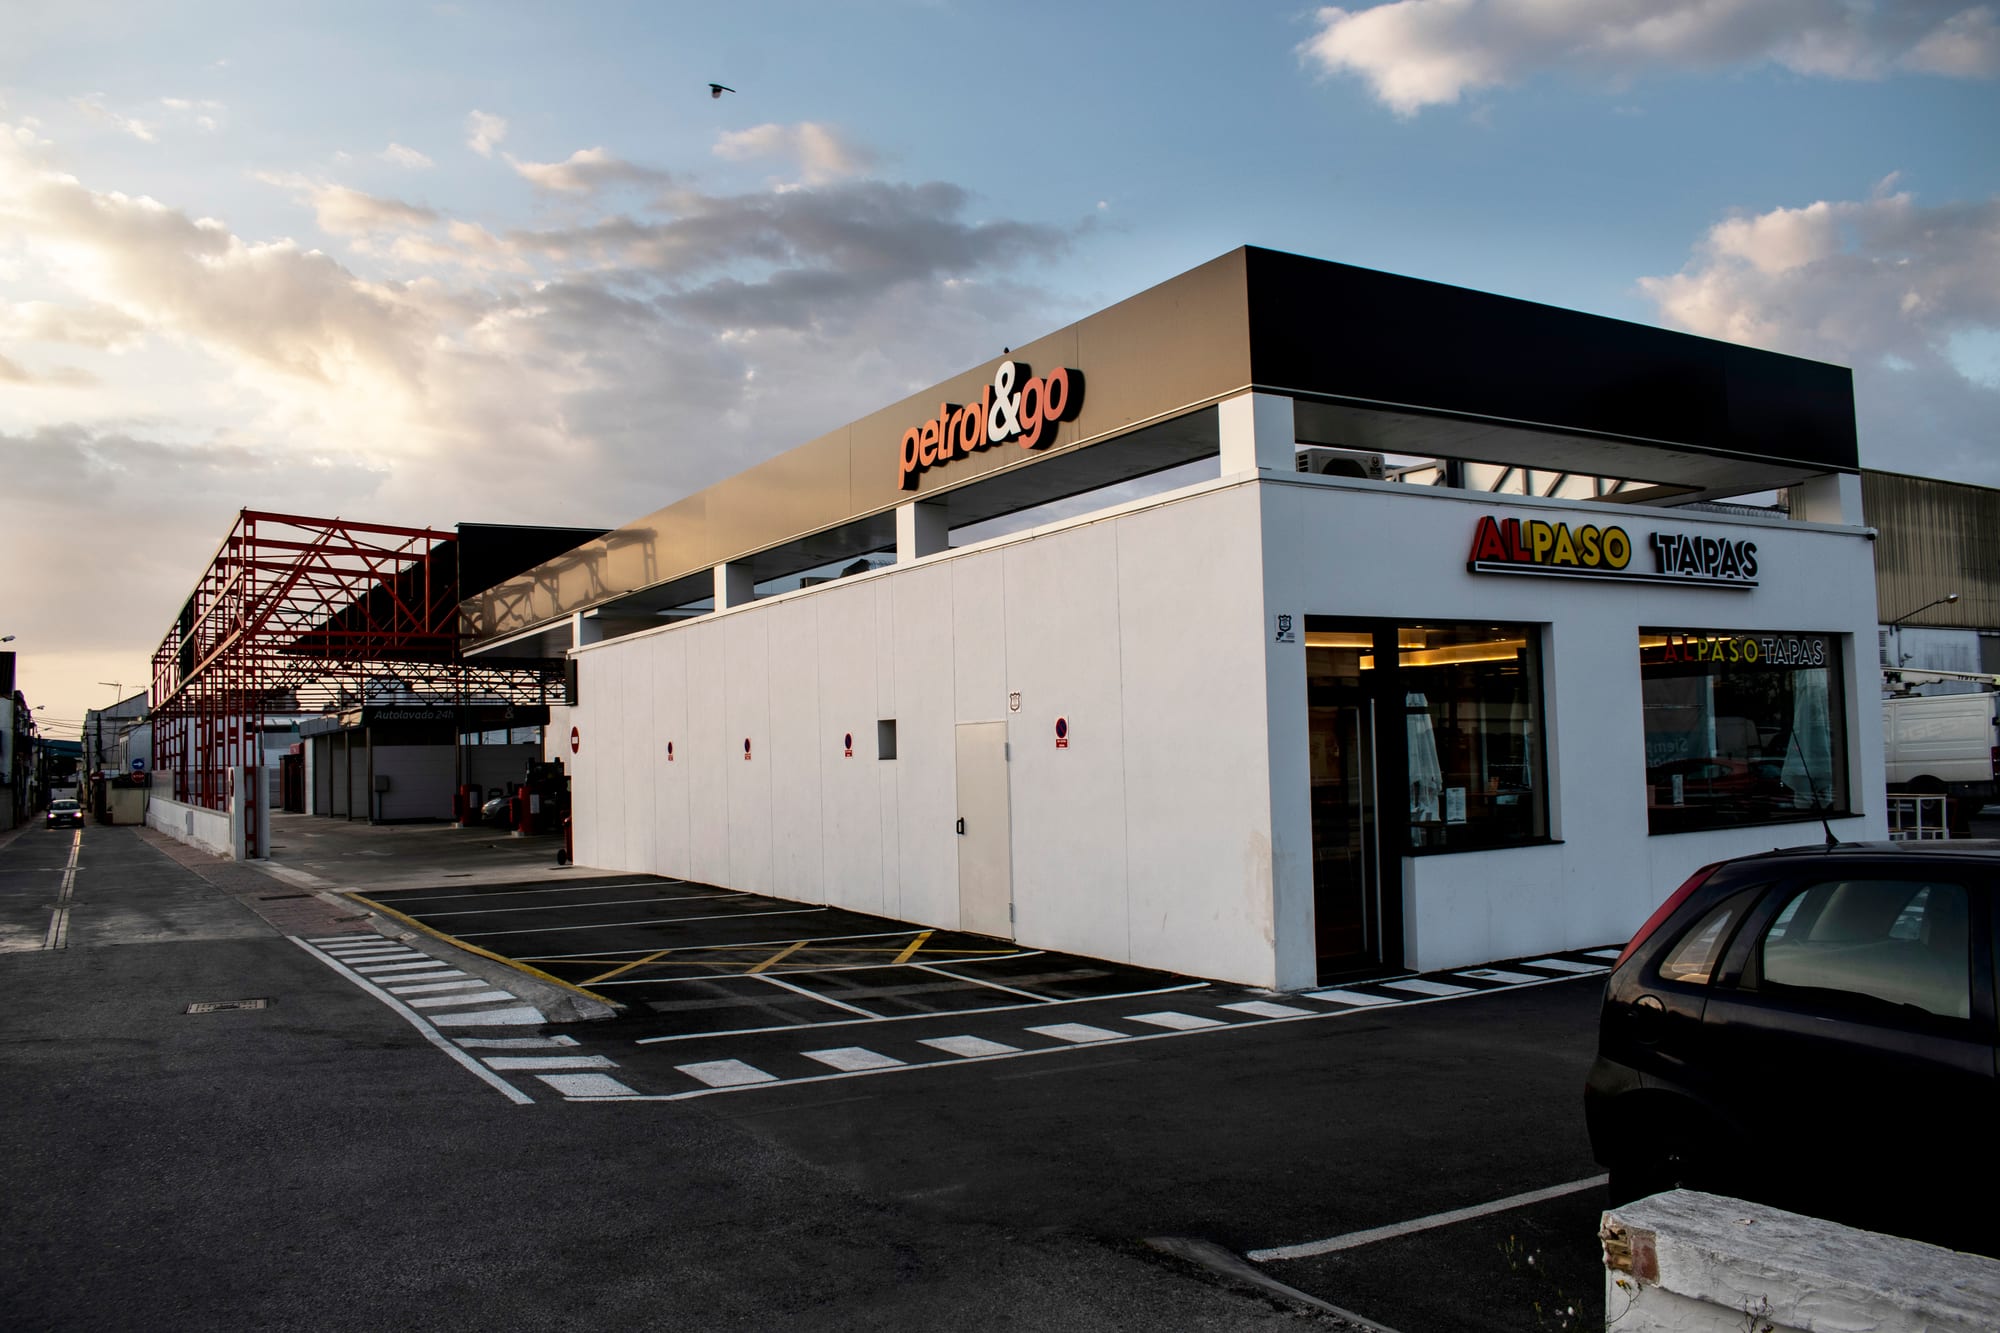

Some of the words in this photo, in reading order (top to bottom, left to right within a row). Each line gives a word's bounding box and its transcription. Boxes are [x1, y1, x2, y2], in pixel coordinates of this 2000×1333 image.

[898, 360, 1074, 490] petrol&go
[1652, 532, 1759, 579] TAPAS
[1761, 638, 1824, 665] TAPAS
[374, 710, 434, 720] Autolavado
[435, 710, 454, 720] 24h
